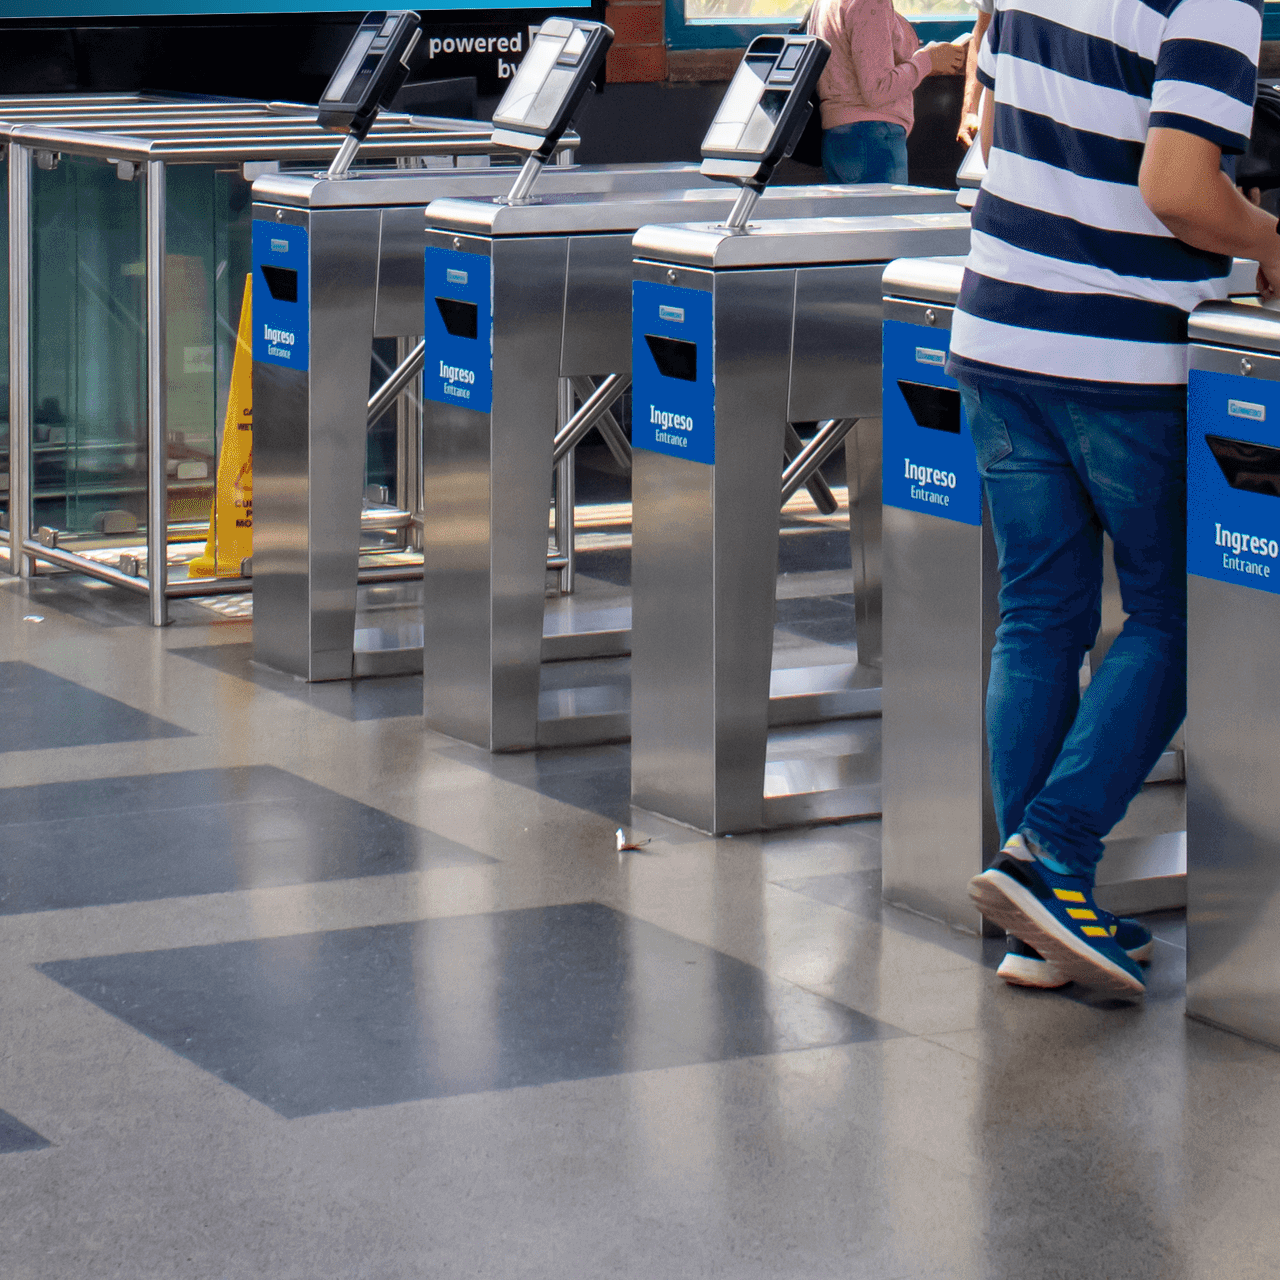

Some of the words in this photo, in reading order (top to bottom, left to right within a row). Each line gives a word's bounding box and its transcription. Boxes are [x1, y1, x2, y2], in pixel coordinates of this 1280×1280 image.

[429, 32, 522, 59] powered
[264, 324, 295, 346] Ingreso
[268, 344, 291, 359] Entrance
[439, 360, 475, 384] Ingreso
[443, 382, 471, 400] Entrance
[650, 404, 693, 431] Ingreso
[655, 429, 687, 448] Entrance
[904, 458, 957, 488] Ingreso
[910, 484, 950, 507] Entrance
[1214, 522, 1279, 558] Ingreso
[1222, 553, 1271, 578] Entrance
